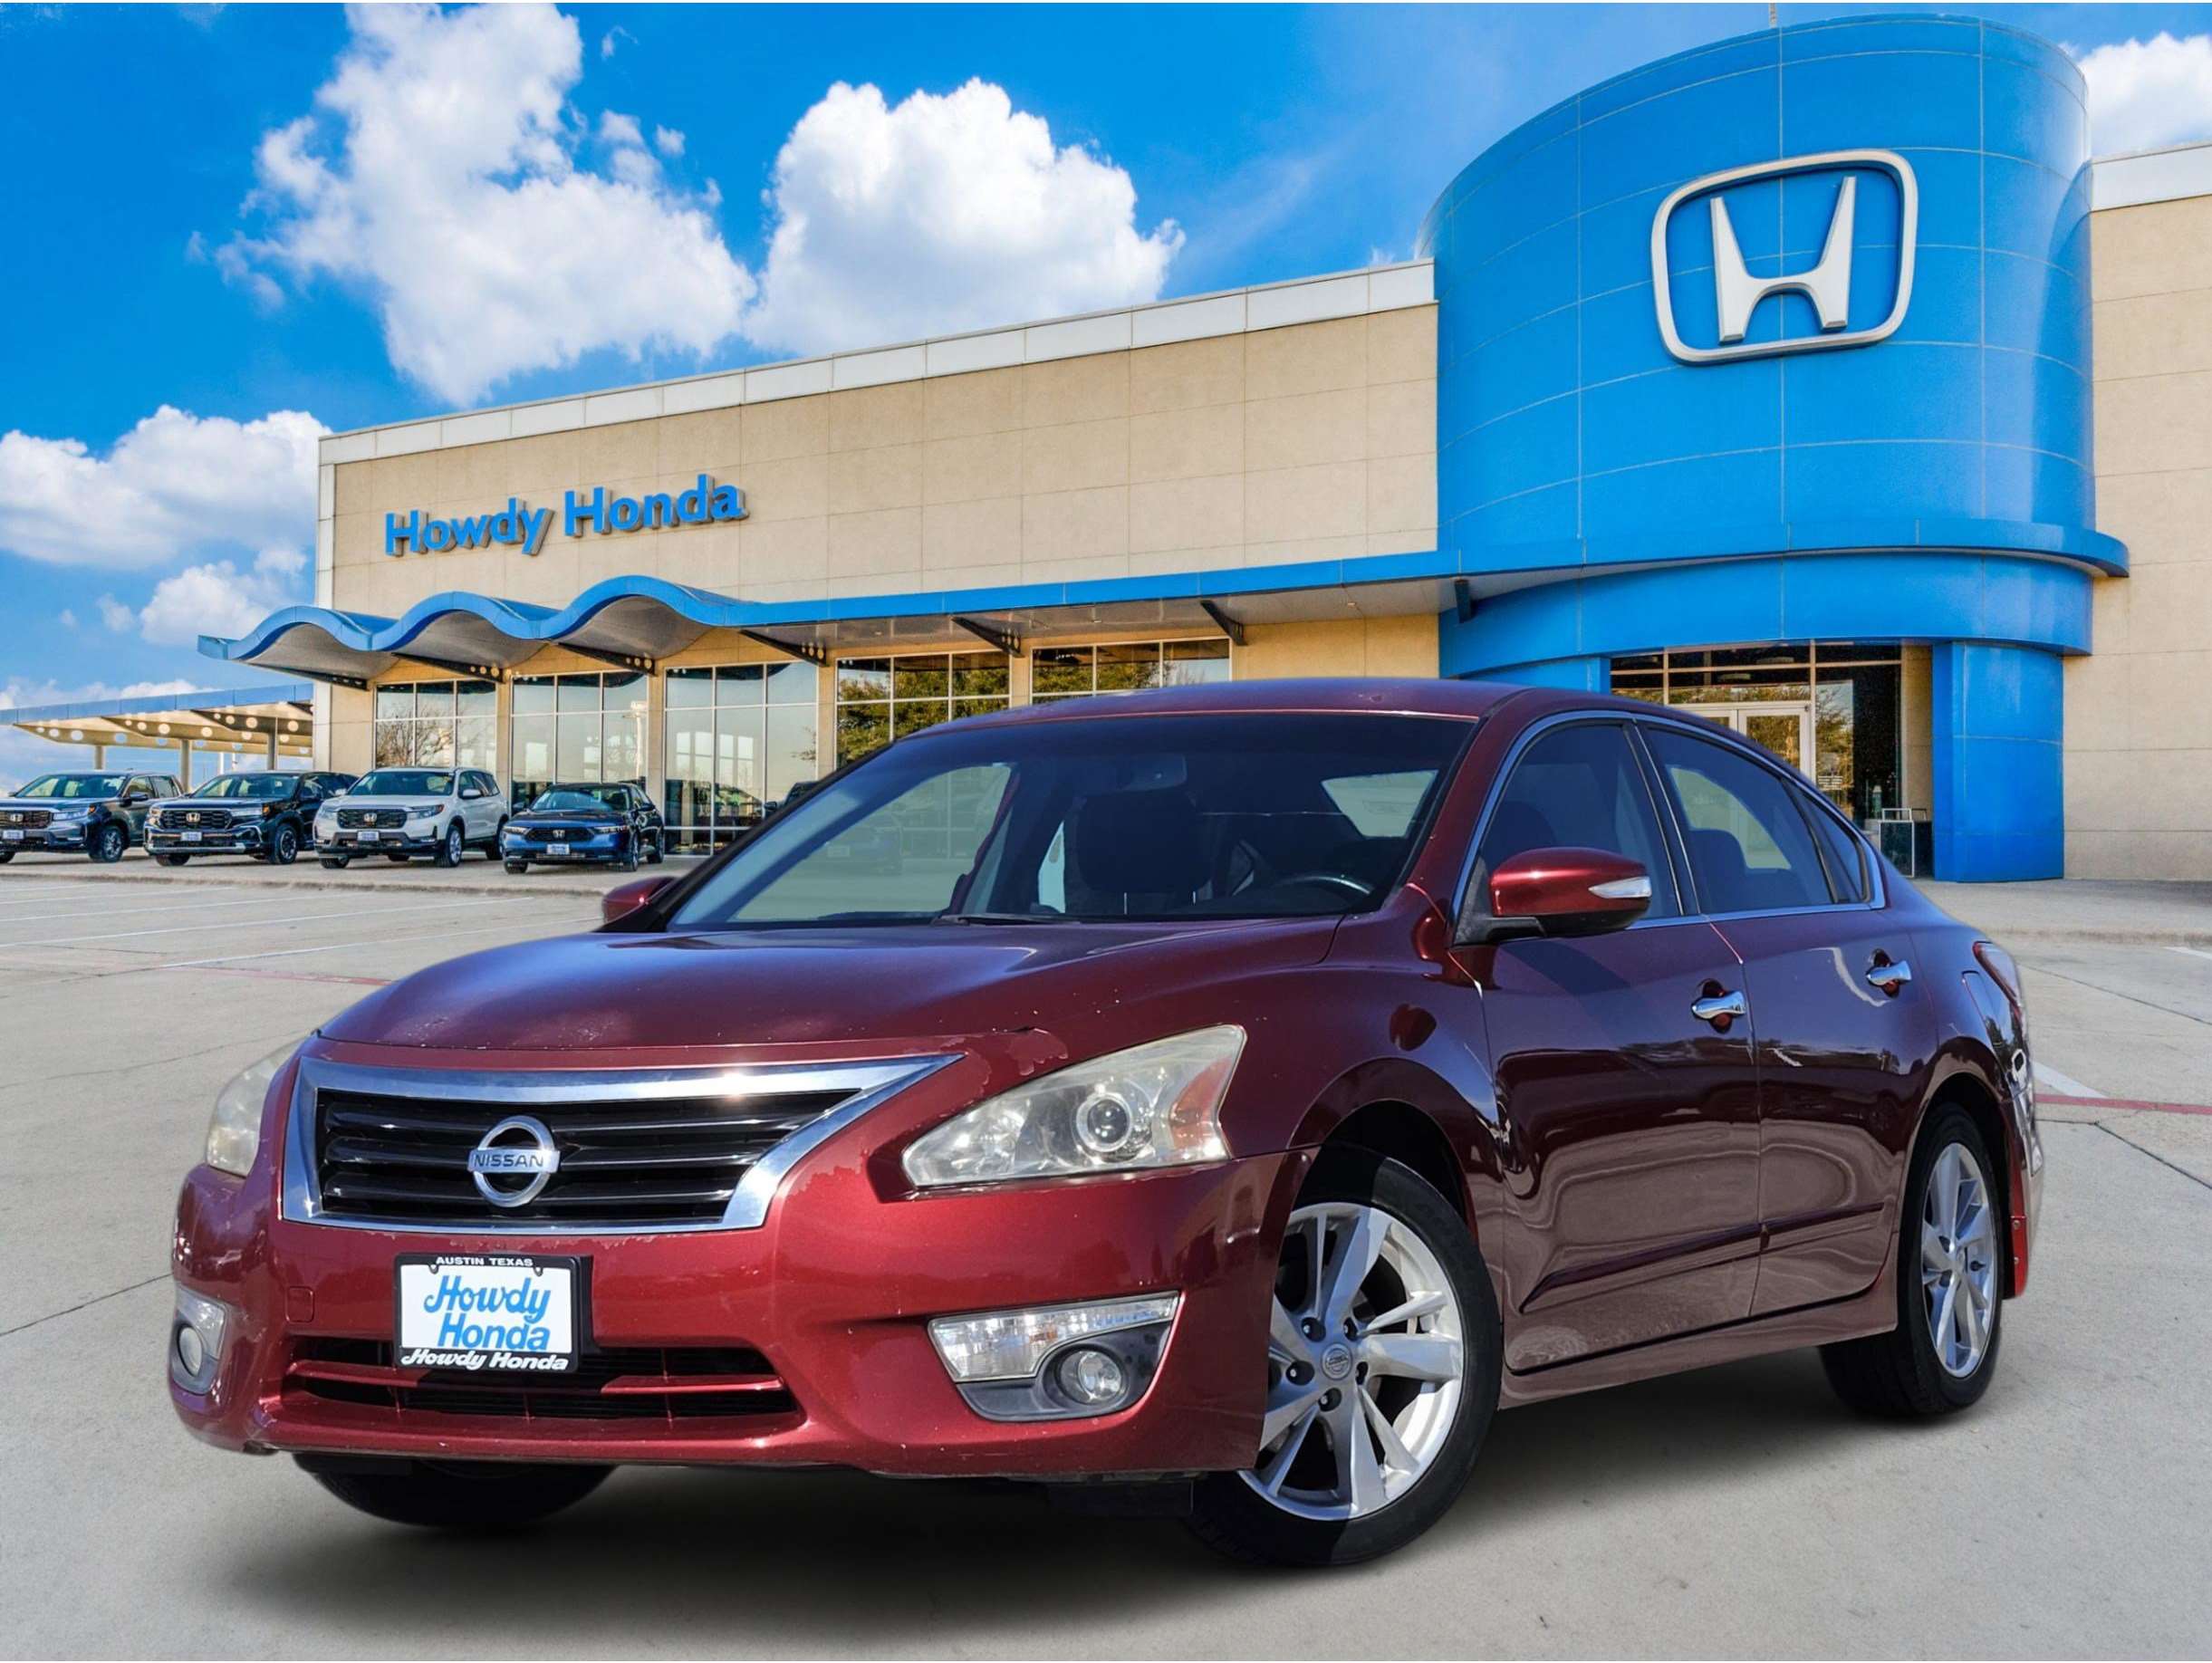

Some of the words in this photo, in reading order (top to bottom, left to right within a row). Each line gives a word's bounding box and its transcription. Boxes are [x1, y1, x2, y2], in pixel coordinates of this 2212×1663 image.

[384, 496, 555, 558] Howdy
[563, 473, 750, 539] Honda
[474, 1154, 543, 1167] NISSAN
[436, 1256, 485, 1266] AUSTIN
[488, 1257, 534, 1267] TEXAS
[423, 1275, 552, 1324] Howdy
[437, 1312, 551, 1351] Honda
[400, 1348, 489, 1370] Howdy
[488, 1351, 569, 1370] Honda
